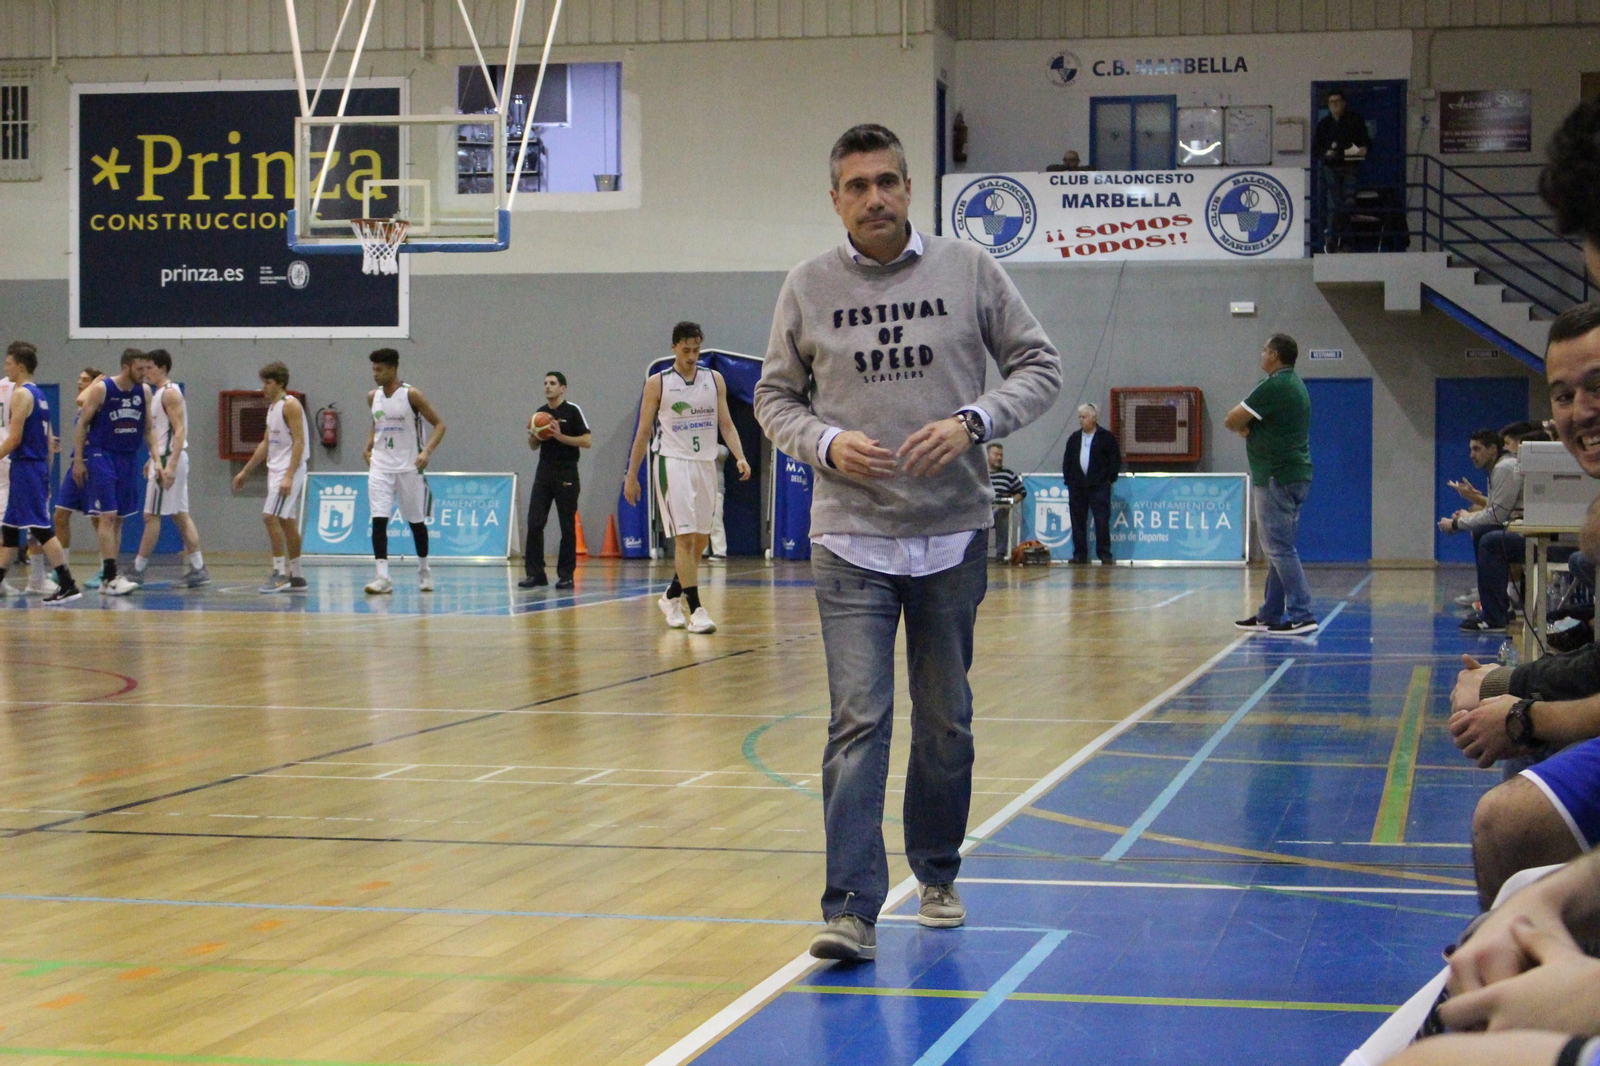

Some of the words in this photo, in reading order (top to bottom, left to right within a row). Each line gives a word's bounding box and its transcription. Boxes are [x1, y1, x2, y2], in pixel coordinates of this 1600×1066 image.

[1093, 60, 1130, 76] C.B.
[1135, 56, 1248, 75] MARBELLA
[136, 130, 387, 201] Prinza
[1050, 174, 1089, 186] CLUB
[1094, 172, 1194, 186] BALONCESTO
[957, 199, 967, 231] CLUB
[978, 179, 1032, 225] BALONCESTO
[1061, 192, 1181, 209] MARBELLA
[1211, 196, 1221, 228] CLUB
[1232, 175, 1288, 222] BALONCESTO
[1054, 231, 1188, 258] TODOS!!
[1219, 232, 1280, 252] MARBELLA
[160, 264, 244, 287] prinza.es
[833, 298, 947, 329] FESTIVAL
[878, 326, 903, 345] OF
[854, 344, 934, 373] SPEED
[864, 370, 924, 384] SCALPERS
[384, 437, 394, 450] 14
[692, 436, 701, 453] 5
[1133, 500, 1215, 510] AYUNTAMIENTO
[1218, 501, 1232, 511] DE
[1127, 530, 1137, 542] de
[1138, 531, 1169, 544] Deportes
